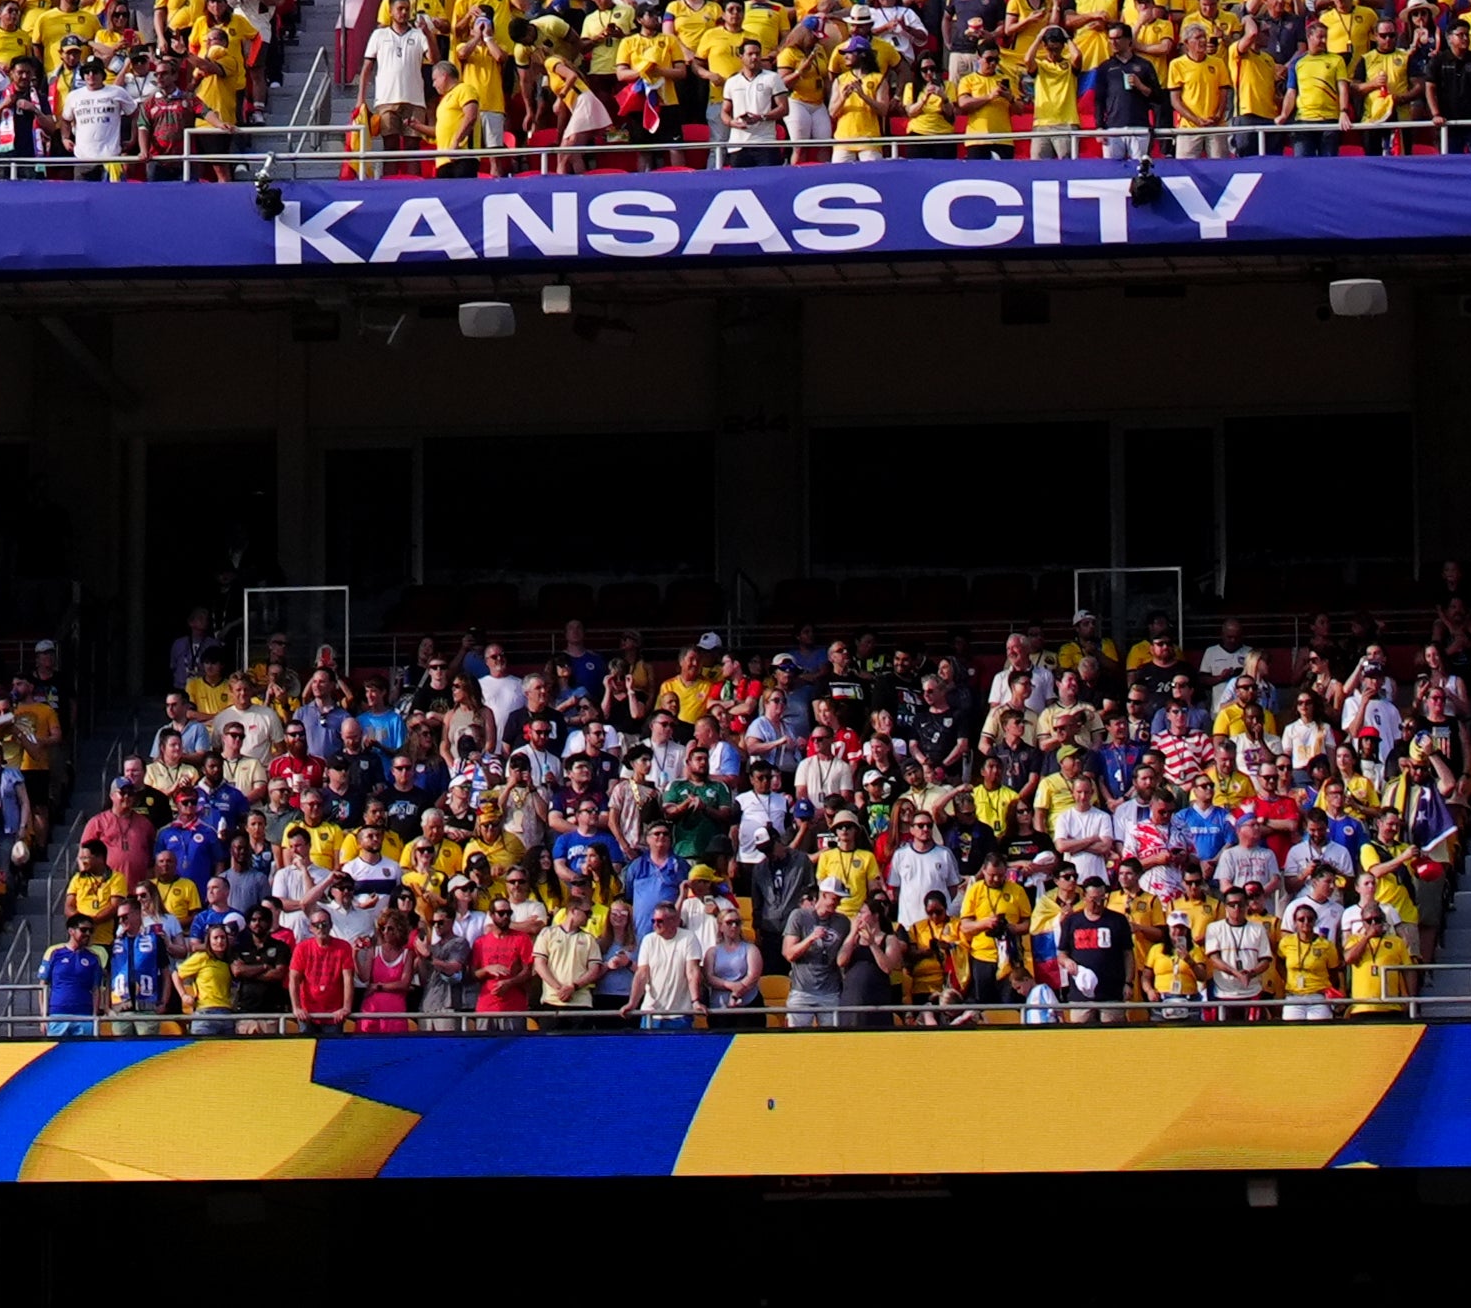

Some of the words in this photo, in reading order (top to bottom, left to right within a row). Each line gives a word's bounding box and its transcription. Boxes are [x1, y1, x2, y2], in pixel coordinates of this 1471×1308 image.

[275, 183, 886, 265] KANSAS
[922, 172, 1263, 247] CITY
[1155, 682, 1171, 693] 26
